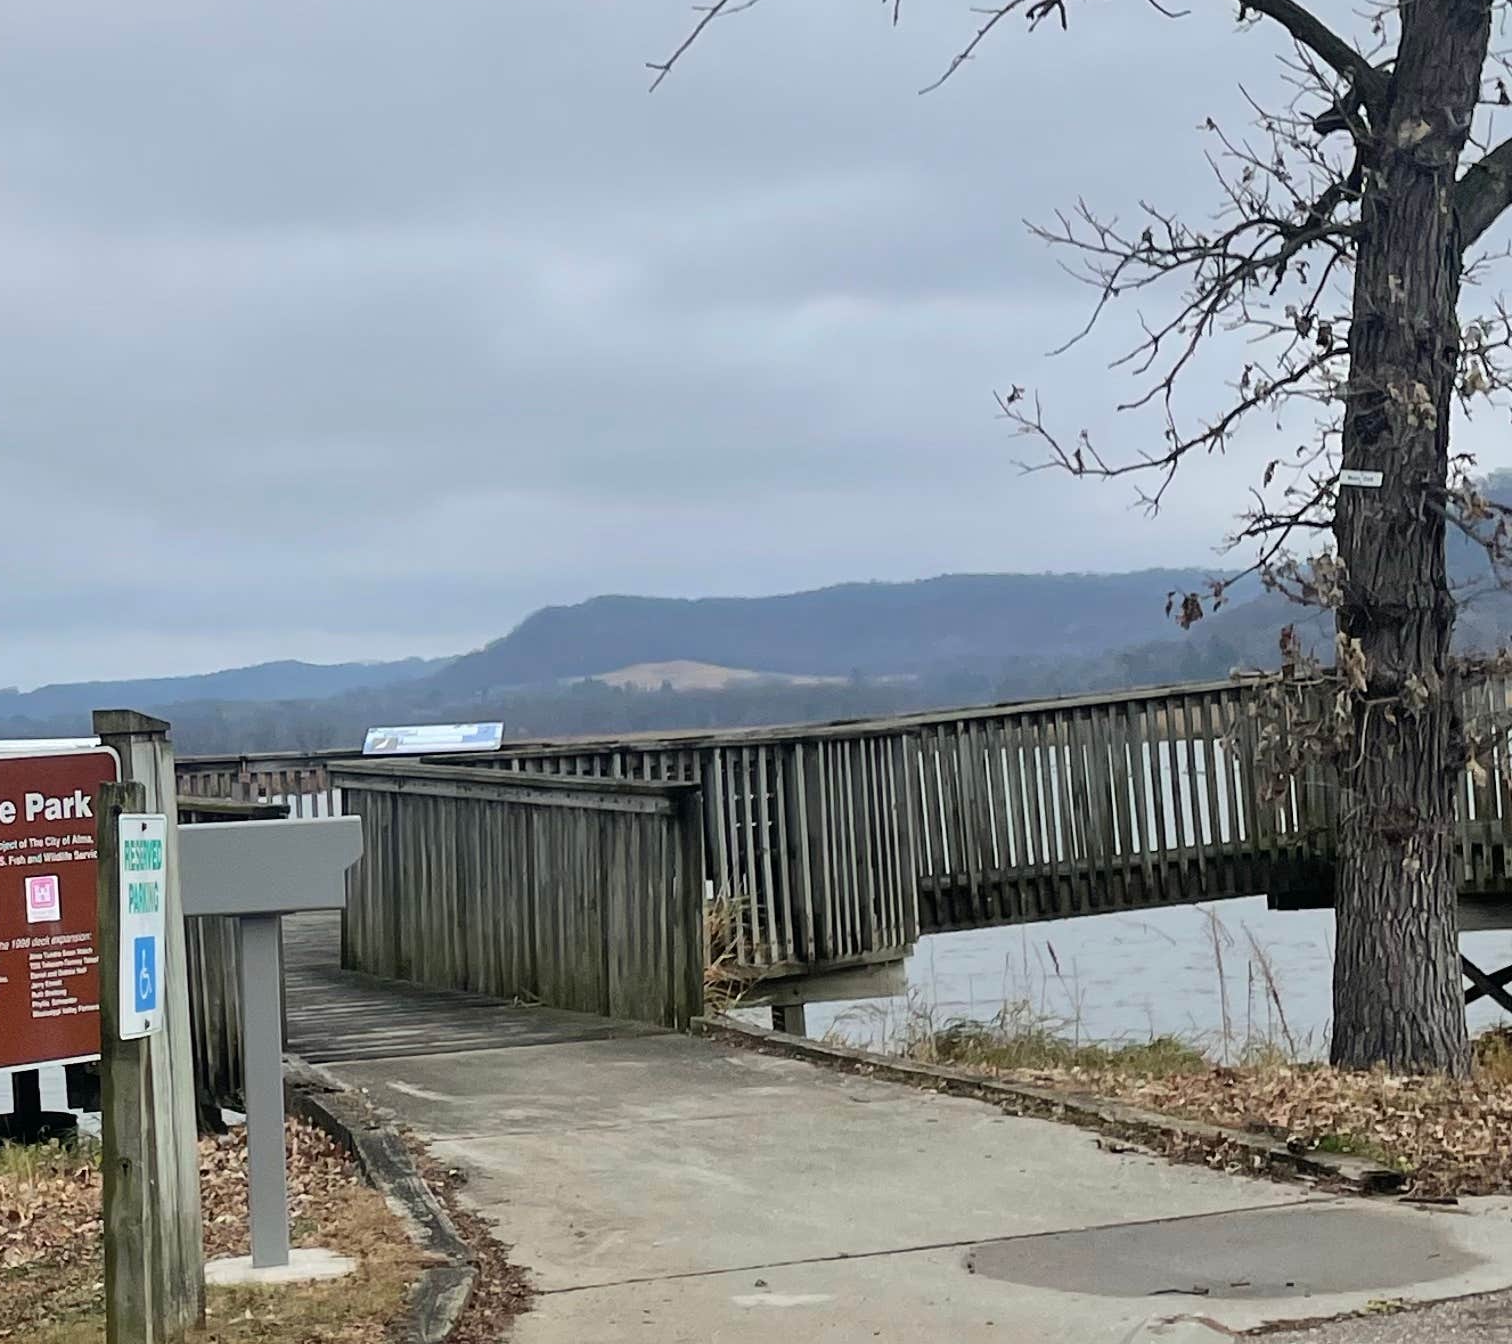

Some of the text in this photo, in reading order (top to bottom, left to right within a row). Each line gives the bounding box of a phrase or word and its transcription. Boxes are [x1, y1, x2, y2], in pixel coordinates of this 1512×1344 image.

[25, 790, 93, 821] Park
[19, 838, 27, 849] of
[29, 838, 43, 847] The
[45, 837, 60, 848] City
[62, 835, 70, 845] of
[124, 840, 162, 871] RESERVED
[8, 855, 26, 865] Fish
[27, 853, 42, 864] and
[43, 851, 72, 862] Wildlife
[128, 881, 159, 914] PARKING
